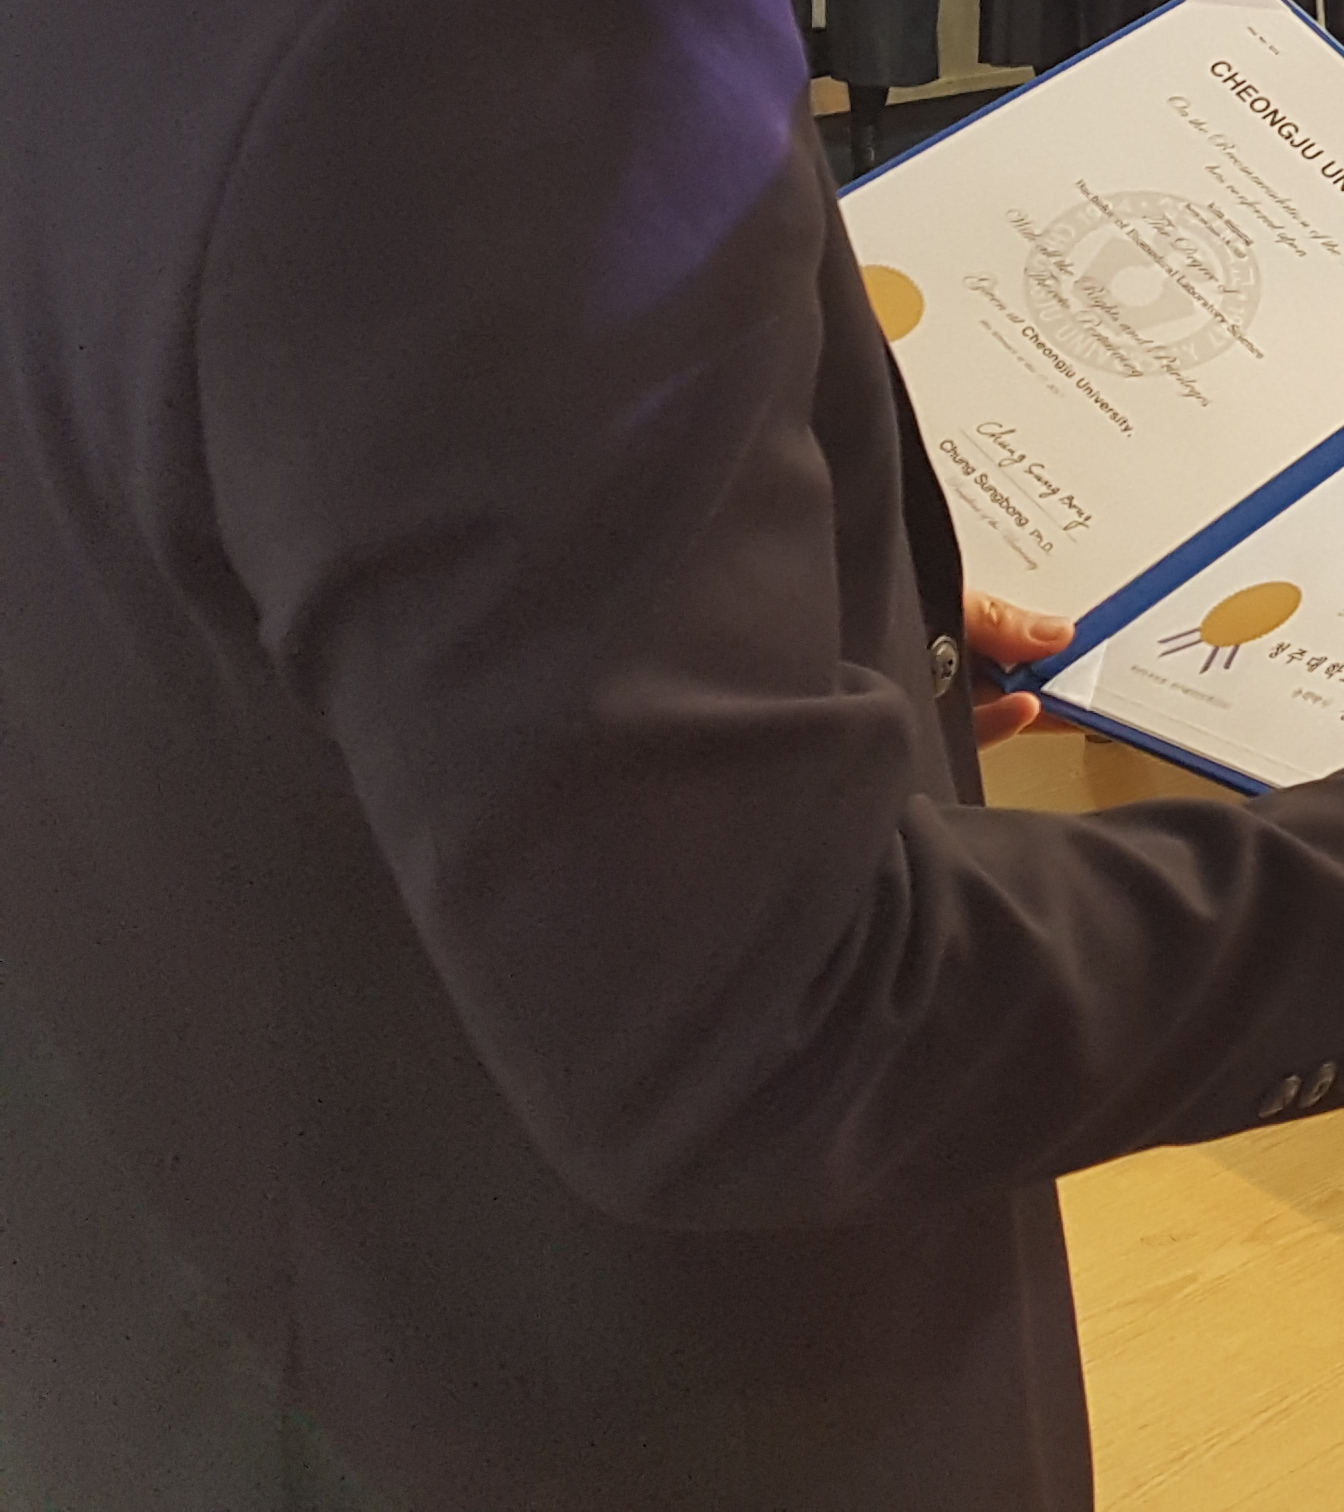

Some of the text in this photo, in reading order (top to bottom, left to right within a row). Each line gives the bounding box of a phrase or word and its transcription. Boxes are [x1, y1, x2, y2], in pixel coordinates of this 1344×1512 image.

[1210, 60, 1325, 160] CHEONGJU
[1021, 325, 1076, 379] Cheongju
[939, 439, 977, 477] Chung
